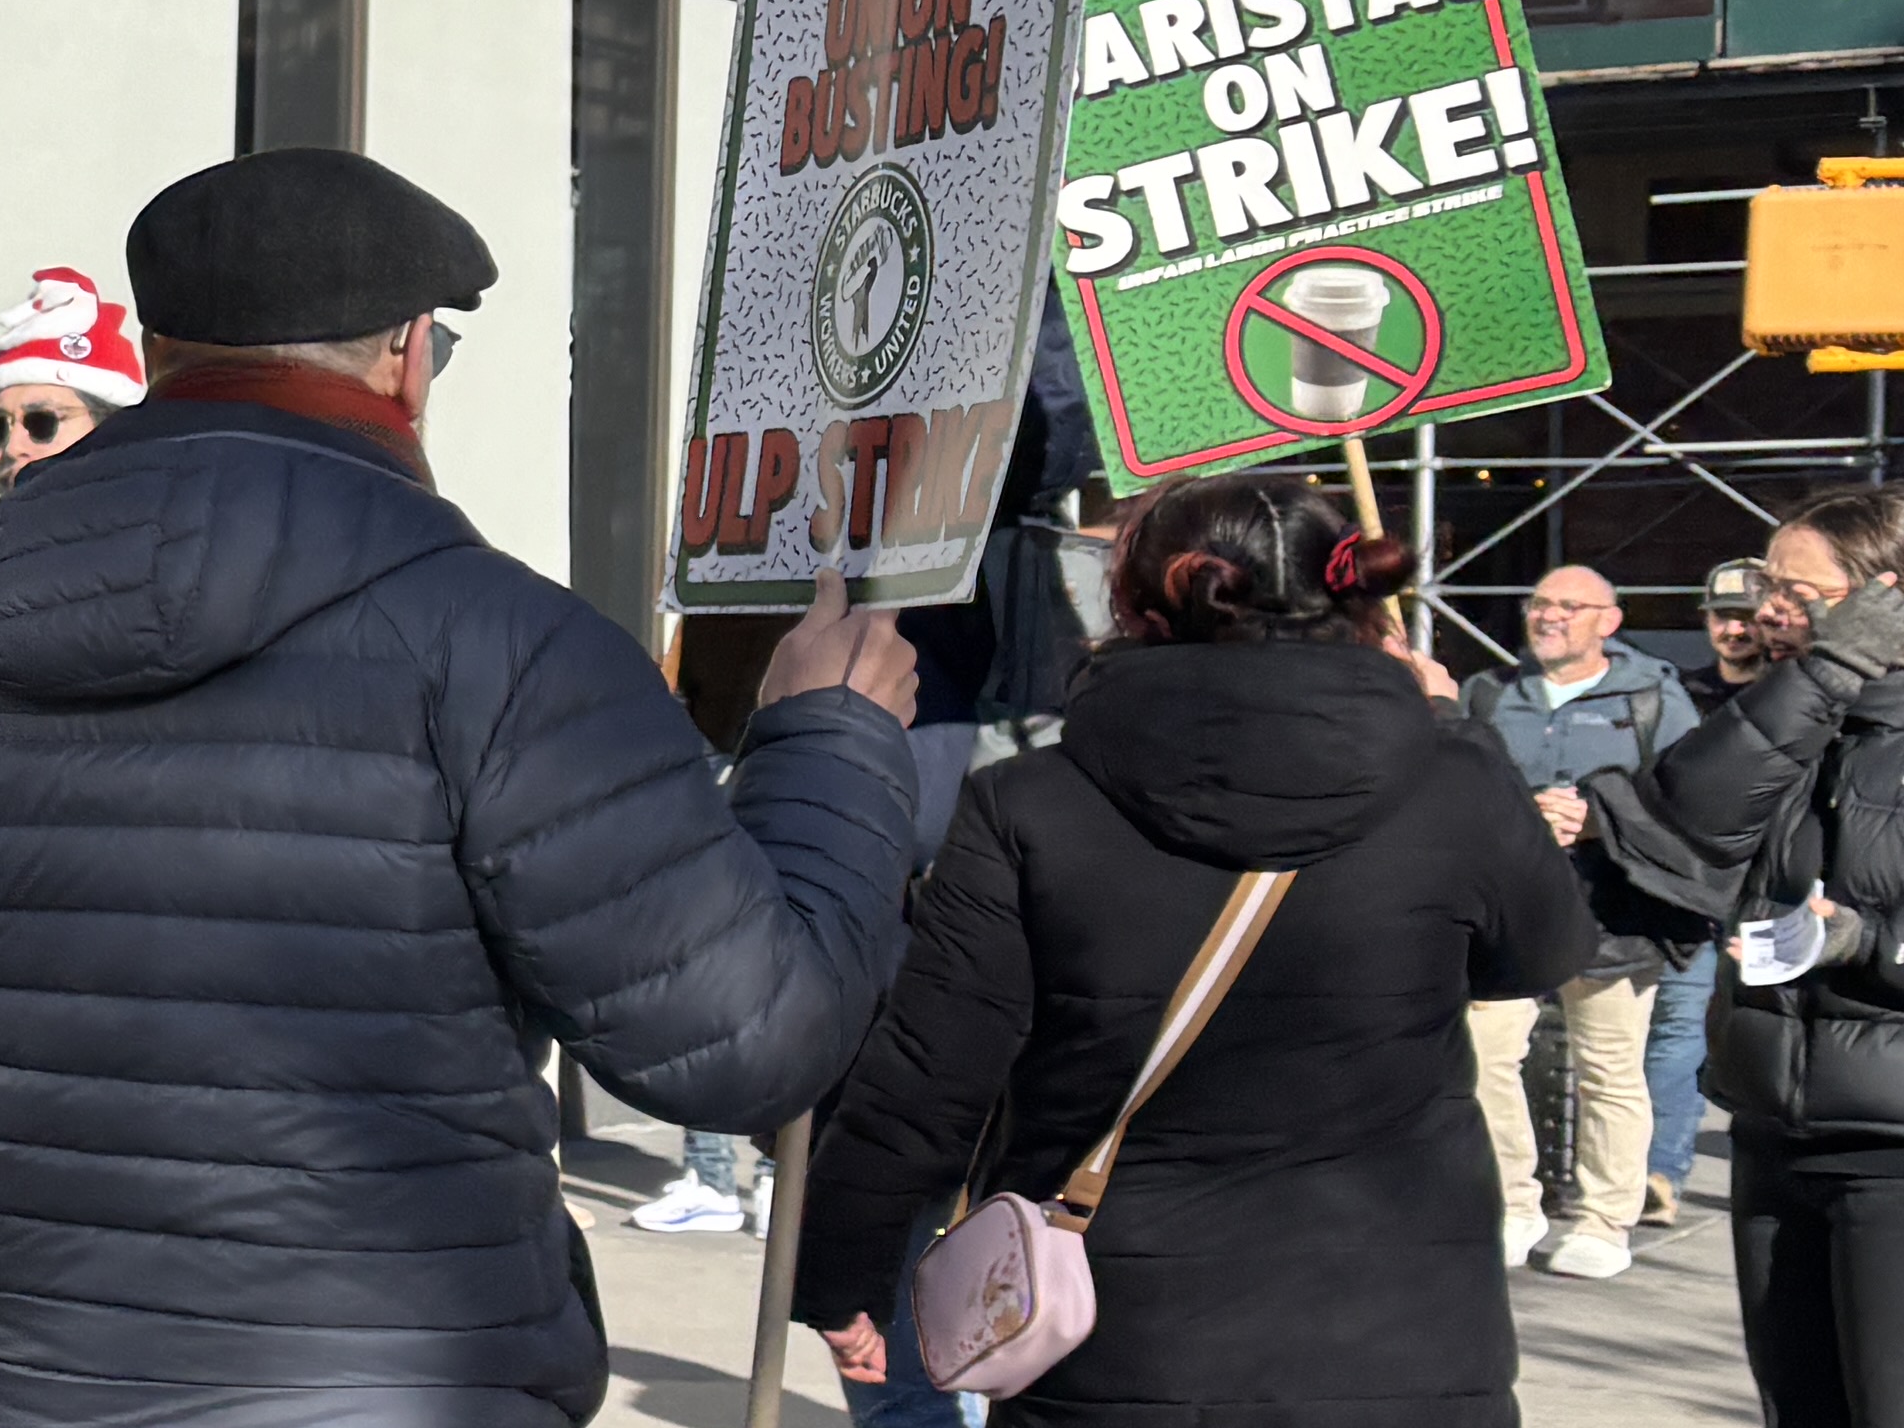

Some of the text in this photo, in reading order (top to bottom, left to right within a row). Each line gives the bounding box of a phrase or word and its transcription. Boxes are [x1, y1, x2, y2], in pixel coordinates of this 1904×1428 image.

[779, 15, 1007, 177] BUSTING!
[1202, 44, 1338, 134] ON
[834, 179, 919, 251] STARBUCKS
[1056, 66, 1540, 275] STRIKE!
[1204, 236, 1286, 269] LABOR
[1288, 205, 1410, 247] PRACTICE
[1410, 184, 1504, 217] STRIKE
[874, 274, 921, 375] UNITED
[680, 397, 1016, 558] ULP STRIKE
